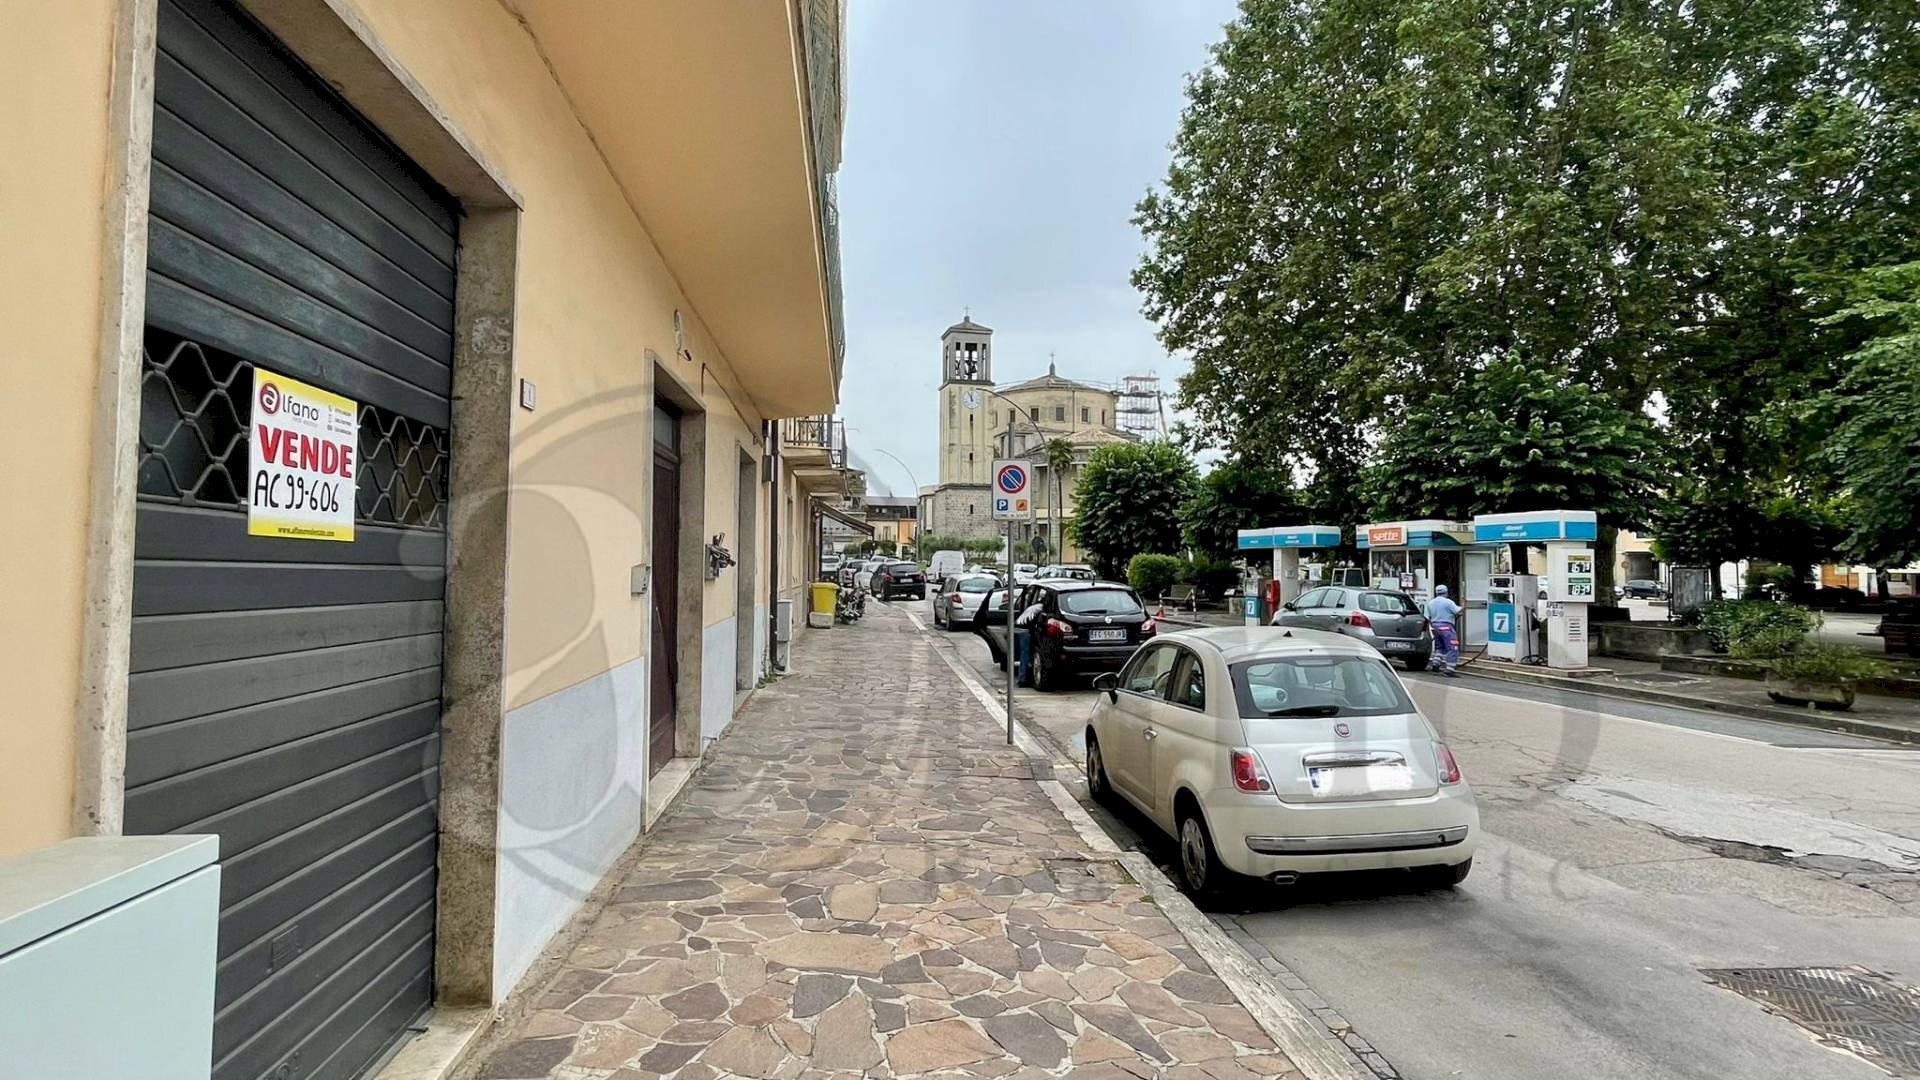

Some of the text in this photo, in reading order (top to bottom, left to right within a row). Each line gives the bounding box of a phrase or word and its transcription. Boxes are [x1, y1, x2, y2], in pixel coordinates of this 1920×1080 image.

[258, 424, 353, 478] VENDE
[254, 470, 281, 508] AC
[1495, 615, 1507, 631] 7
